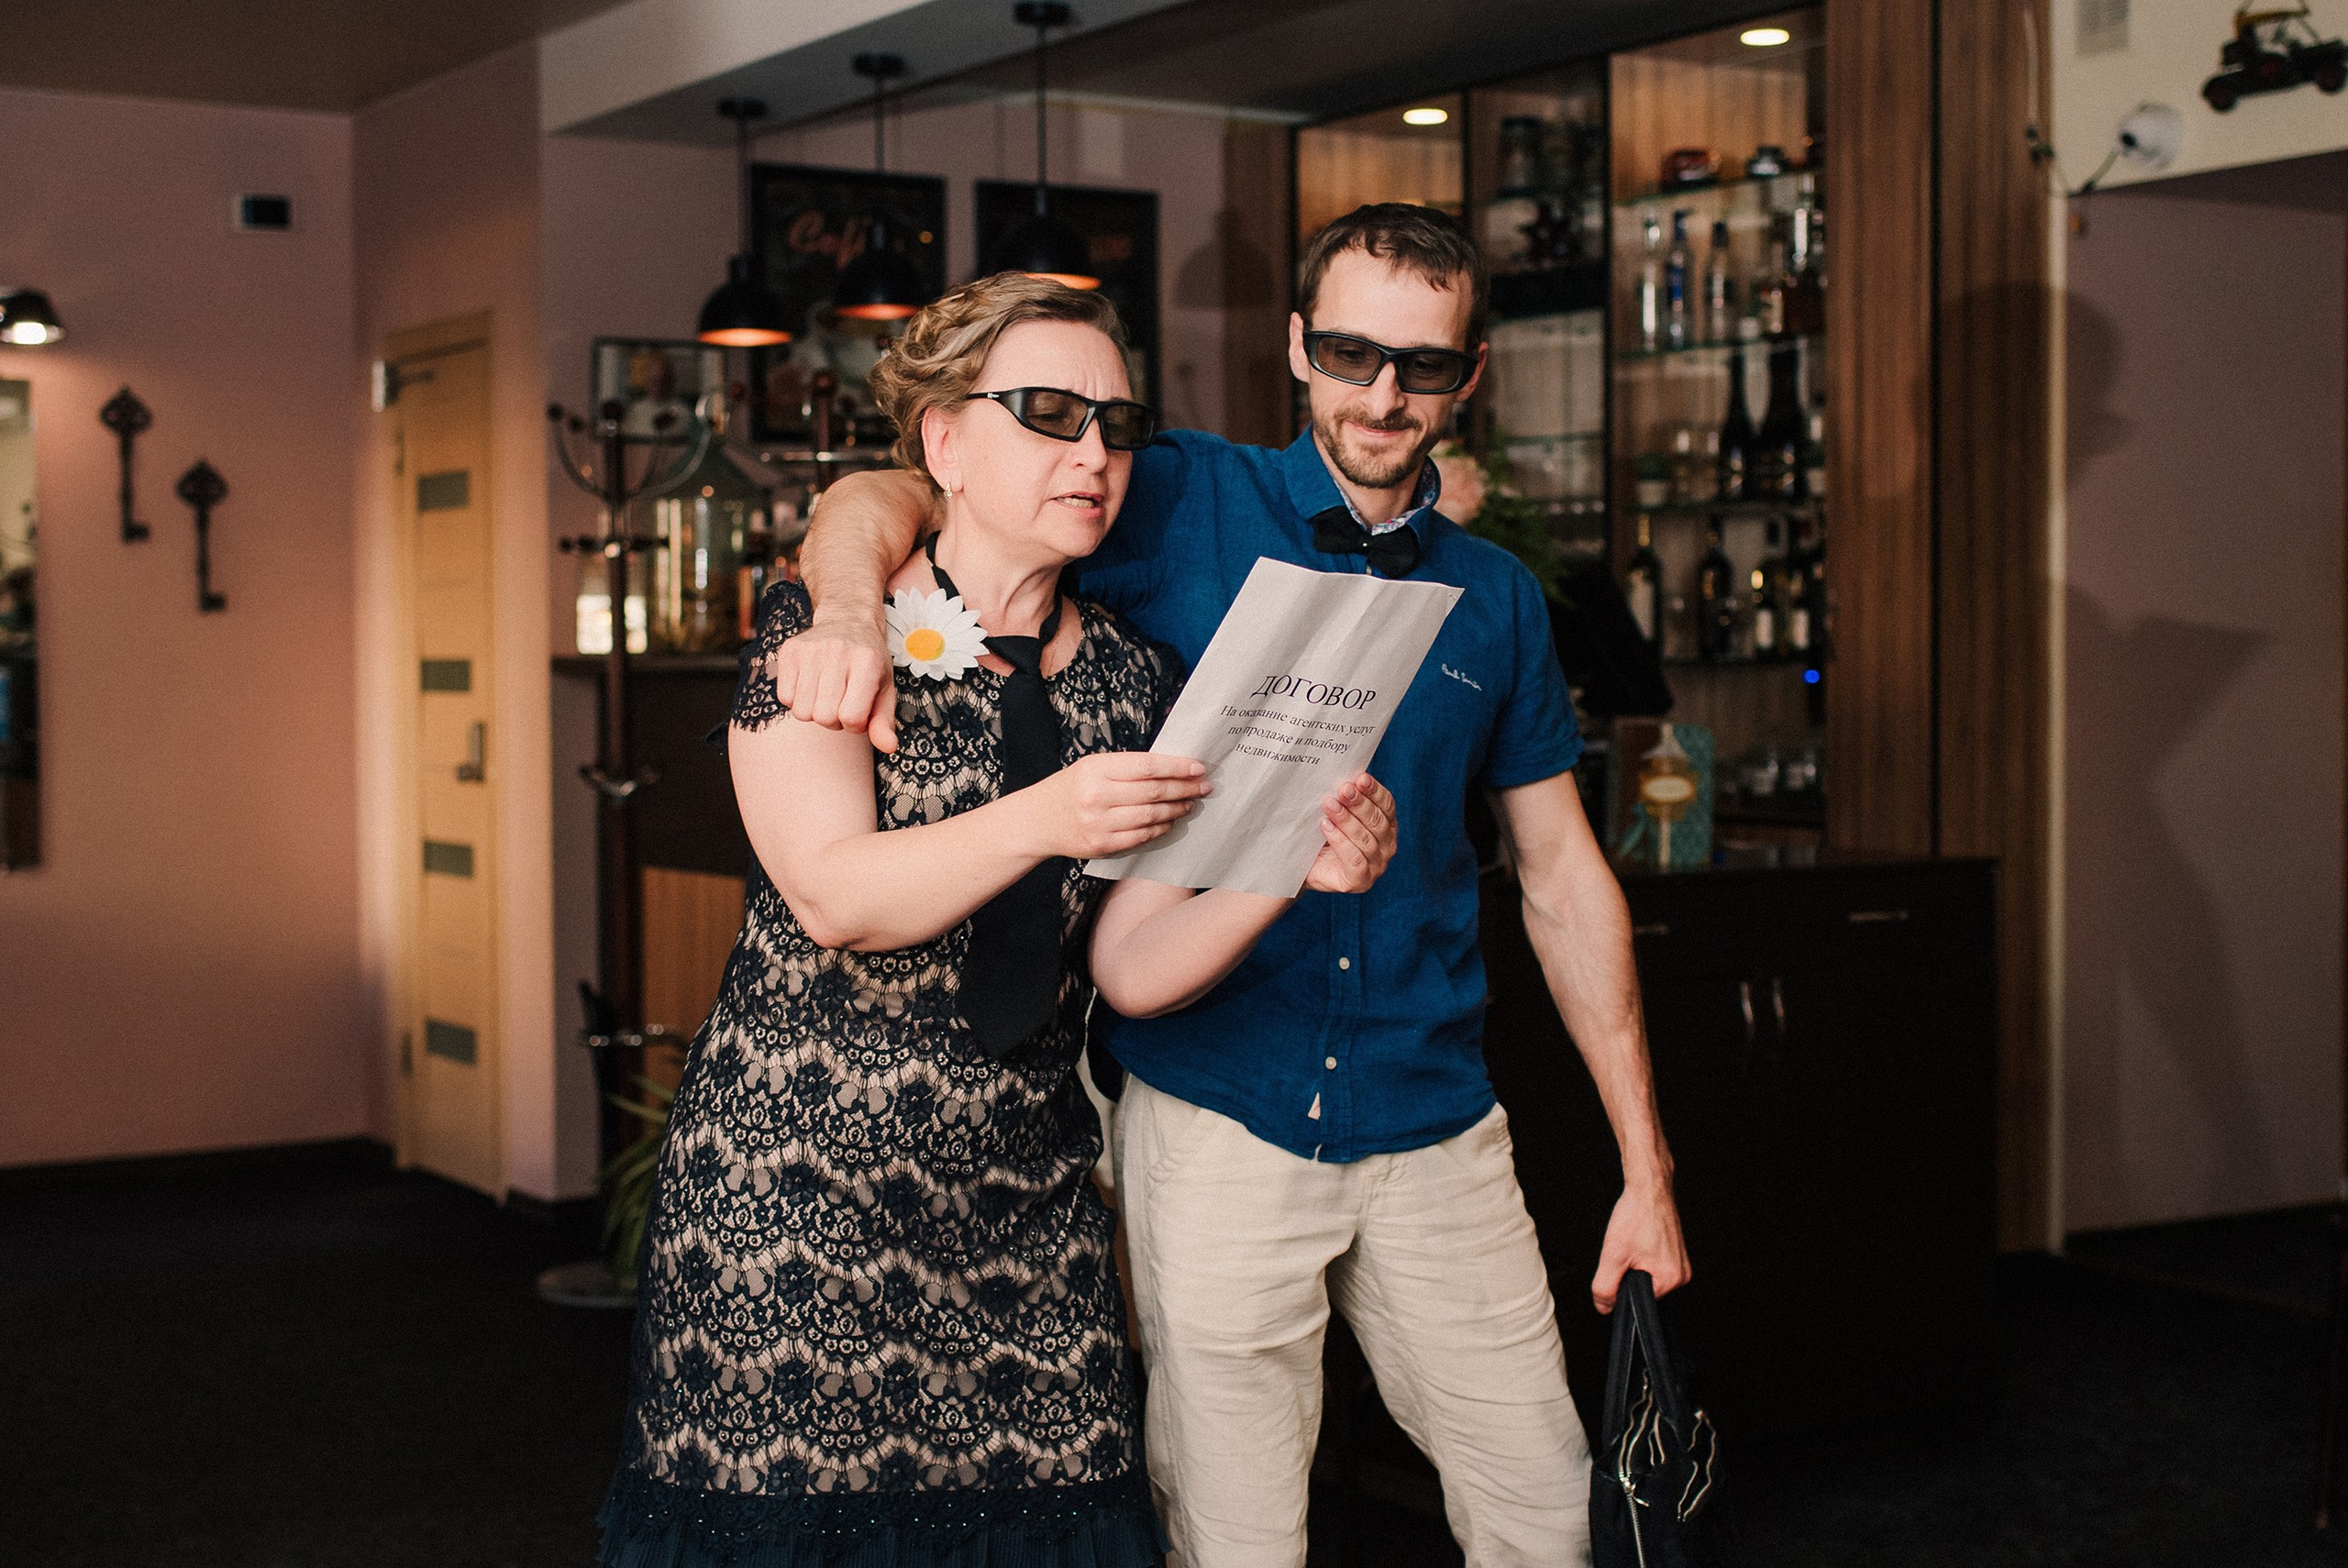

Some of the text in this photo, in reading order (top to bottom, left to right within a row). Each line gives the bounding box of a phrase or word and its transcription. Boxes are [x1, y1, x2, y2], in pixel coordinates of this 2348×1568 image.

[1249, 674, 1377, 711] ДОГОВОР
[1220, 705, 1376, 736] На оказание агентских услуг
[1227, 725, 1351, 755] по продаже и подбору
[1235, 743, 1321, 765] недвижимости
